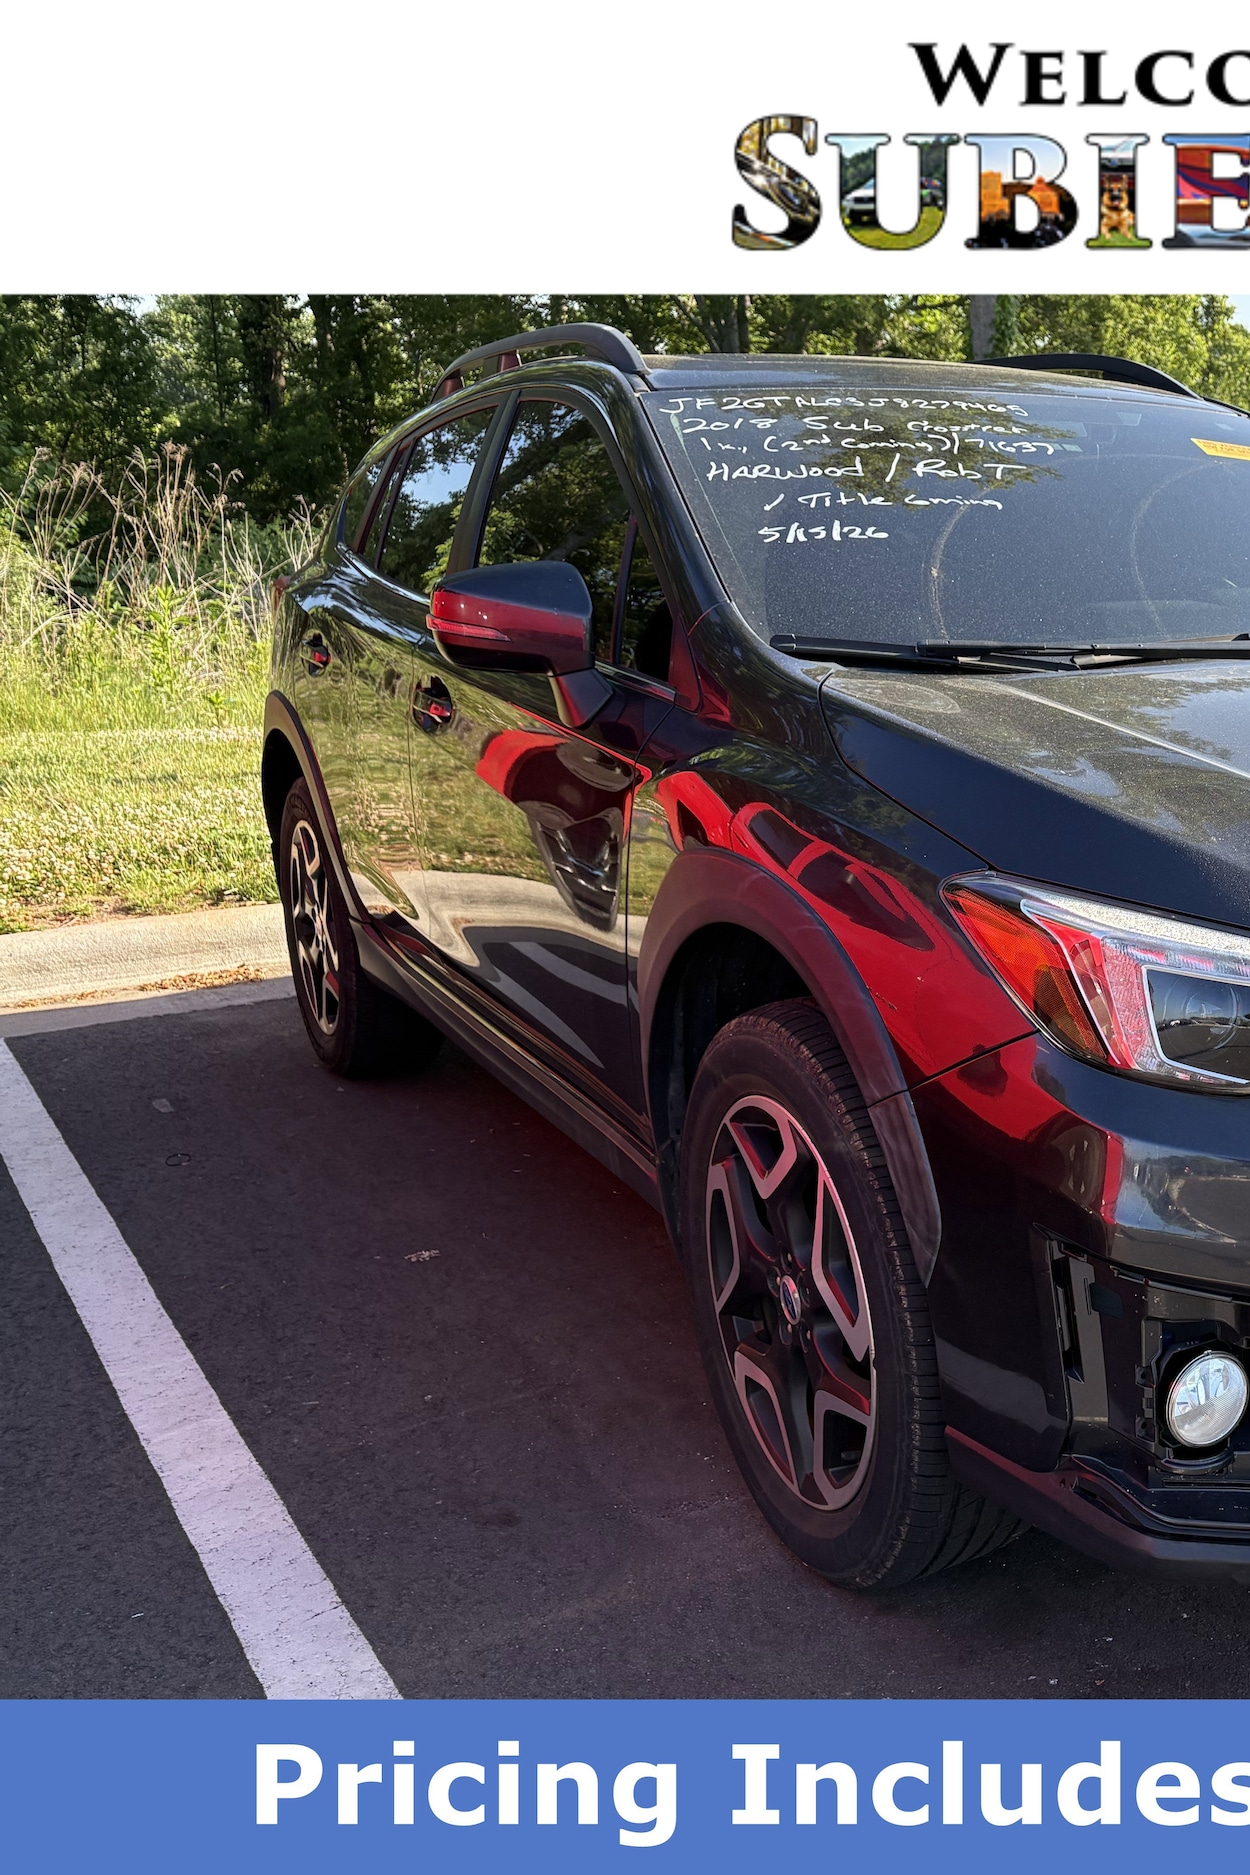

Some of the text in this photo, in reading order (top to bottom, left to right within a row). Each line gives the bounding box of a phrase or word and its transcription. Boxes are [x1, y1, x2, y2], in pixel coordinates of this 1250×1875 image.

[683, 417, 778, 434] 2018
[802, 416, 885, 431] Sub
[798, 491, 893, 508] Title
[758, 519, 889, 544] 5/15/26
